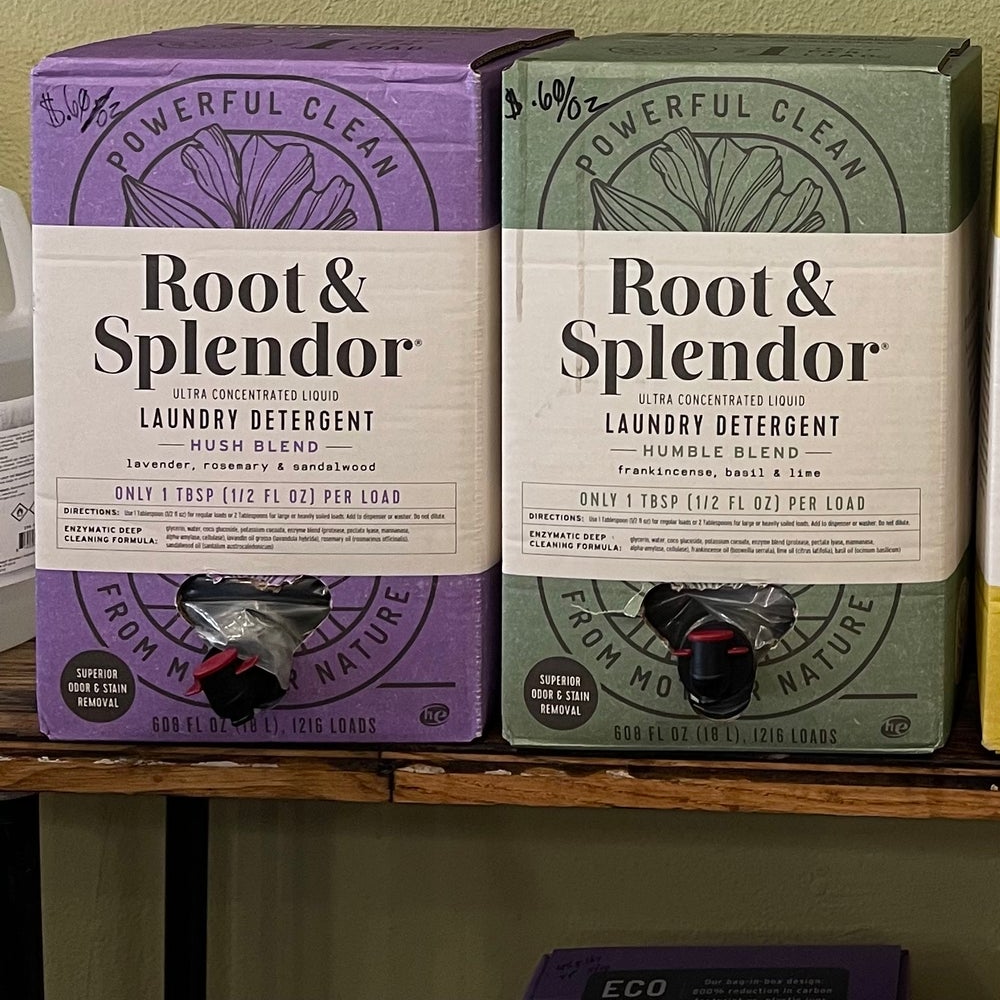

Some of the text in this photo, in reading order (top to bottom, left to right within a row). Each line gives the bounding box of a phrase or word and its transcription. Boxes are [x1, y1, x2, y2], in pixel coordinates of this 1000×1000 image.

[107, 90, 398, 178] POWERFUL CLEAN
[575, 93, 866, 181] POWERFUL CLEAN
[141, 254, 369, 313] Root &
[608, 257, 836, 317] Root &
[173, 388, 339, 402] ULTRA CONCENTRATED LIQUID
[639, 393, 805, 408] ULTRA CONCENTRATED LIQUID
[140, 407, 374, 432] LAUNDRY DETERGENT
[606, 413, 840, 437] LAUNDRY DETERGENT
[191, 439, 319, 453] HUSH BLEND
[643, 444, 799, 459] HUMBLE BLEND
[127, 459, 376, 473] lavender, rosemary & sandalwood
[618, 465, 821, 478] frankincense, basil & lime
[114, 486, 400, 505] ONLY 1 TBSP (1/2 FL OZ) PER LOAD
[540, 674, 581, 686] SUPERIOR
[531, 689, 590, 701] ODOR & STAIN
[540, 703, 581, 716] REMOVAL
[602, 979, 667, 998] ECO
